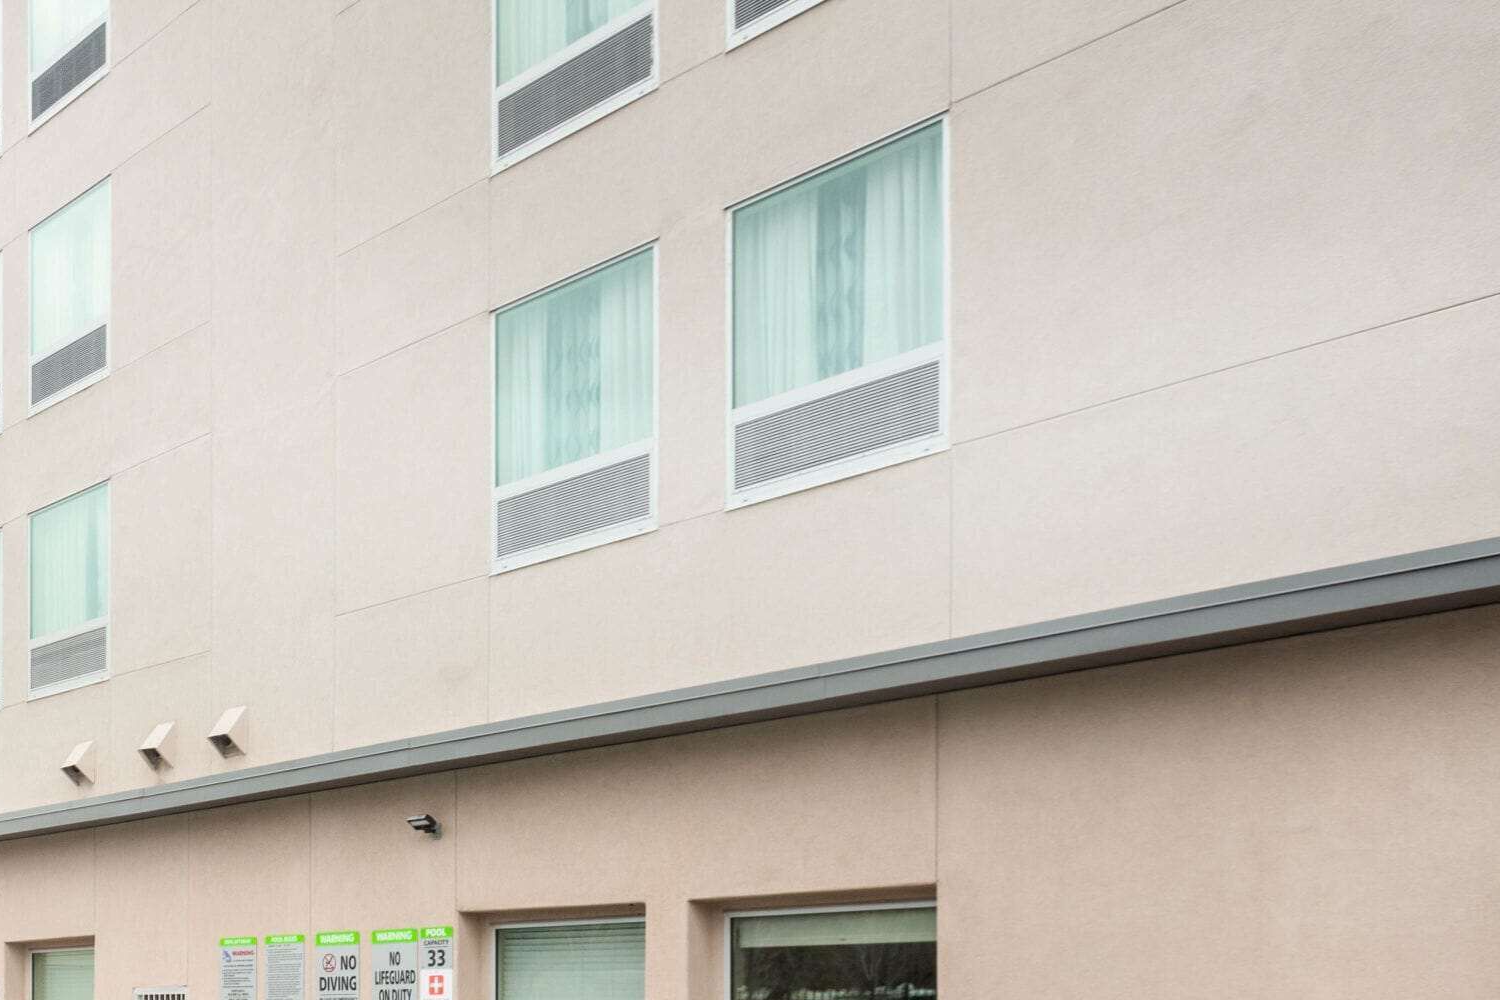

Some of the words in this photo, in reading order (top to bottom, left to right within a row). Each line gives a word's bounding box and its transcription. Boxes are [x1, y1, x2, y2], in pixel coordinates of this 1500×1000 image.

[320, 934, 354, 944] WARNING
[375, 931, 412, 942] WARNING
[340, 955, 357, 970] NO
[389, 951, 401, 966] NO
[427, 949, 446, 967] 33
[319, 976, 357, 991] DIVING
[375, 969, 416, 985] LIFEGUARD
